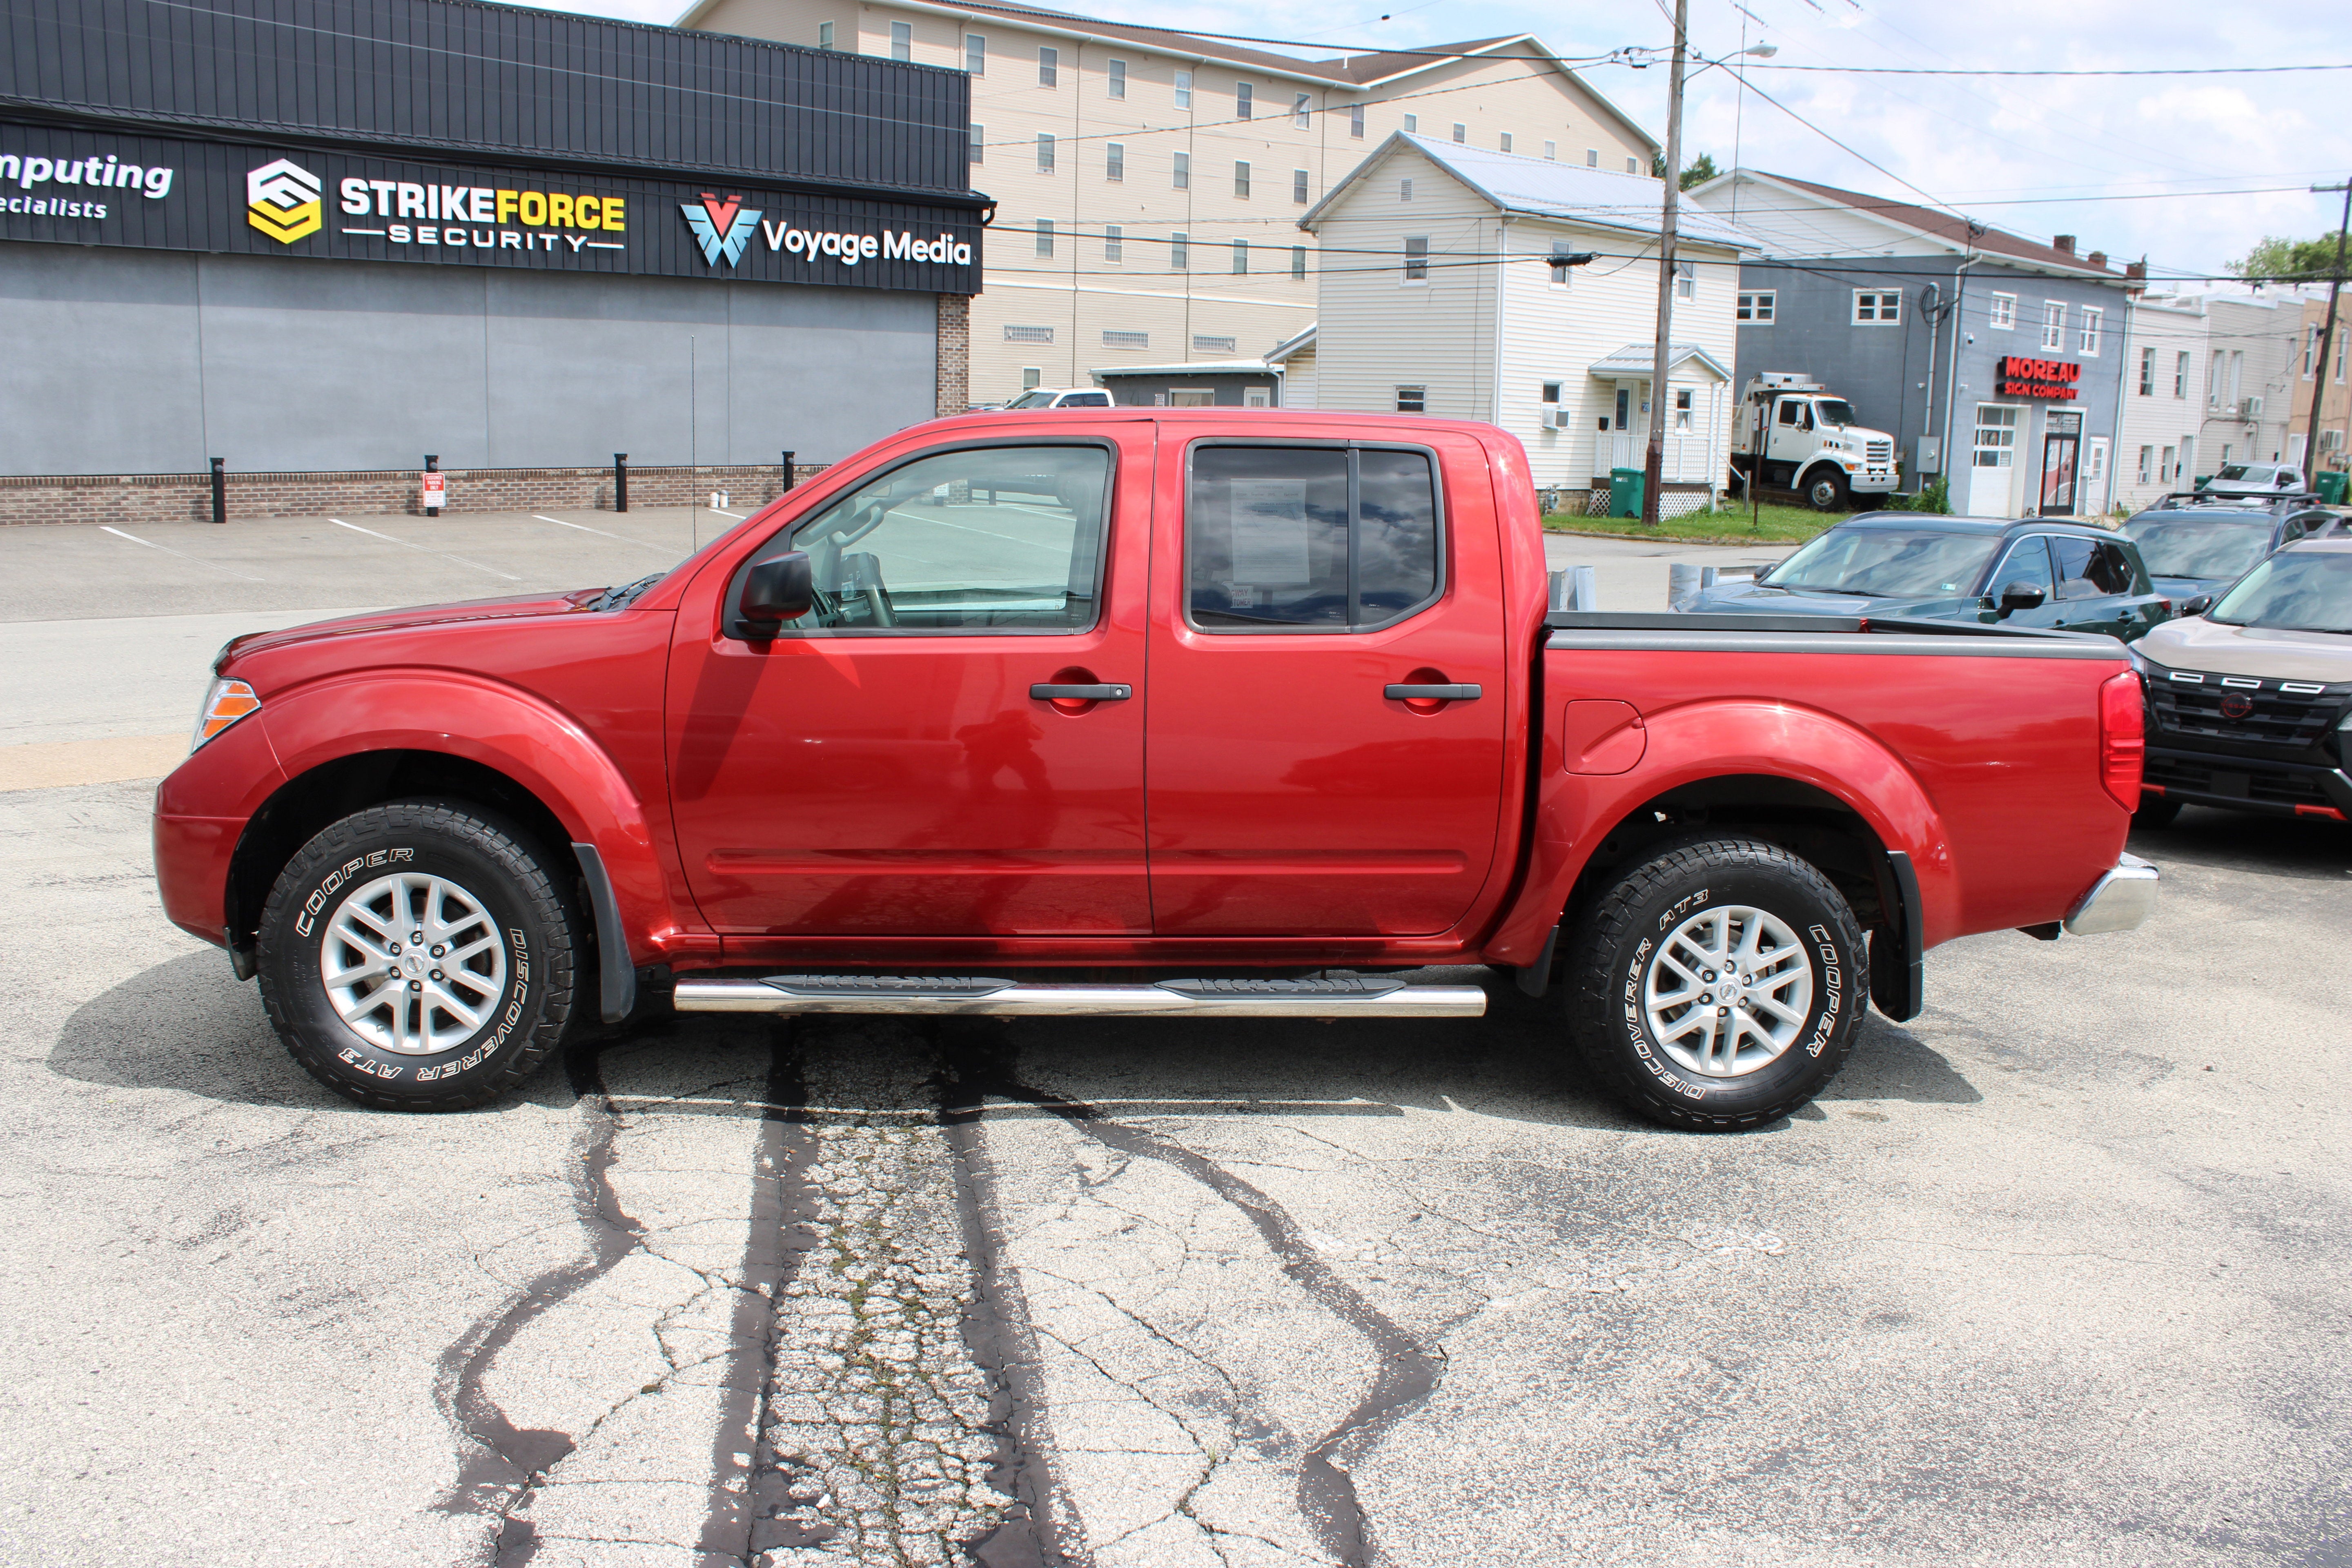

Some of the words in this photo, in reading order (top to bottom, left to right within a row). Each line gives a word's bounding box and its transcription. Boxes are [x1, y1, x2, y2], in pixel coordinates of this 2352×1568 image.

[341, 178, 625, 231] STRIKEFORCE
[389, 224, 588, 252] SECURITY
[762, 220, 878, 265] Voyage
[883, 230, 971, 265] Media
[2005, 381, 2031, 396] SIGN
[2032, 384, 2079, 400] COMPANY
[2006, 356, 2081, 383] MOREAU
[296, 848, 414, 938] COOPER
[1659, 889, 1709, 931] AT3
[417, 928, 530, 1081] DISCOVERER
[1806, 924, 1842, 1058] COOPER
[1624, 938, 1706, 1100] DISCOVERER
[338, 1047, 403, 1079] AT3
